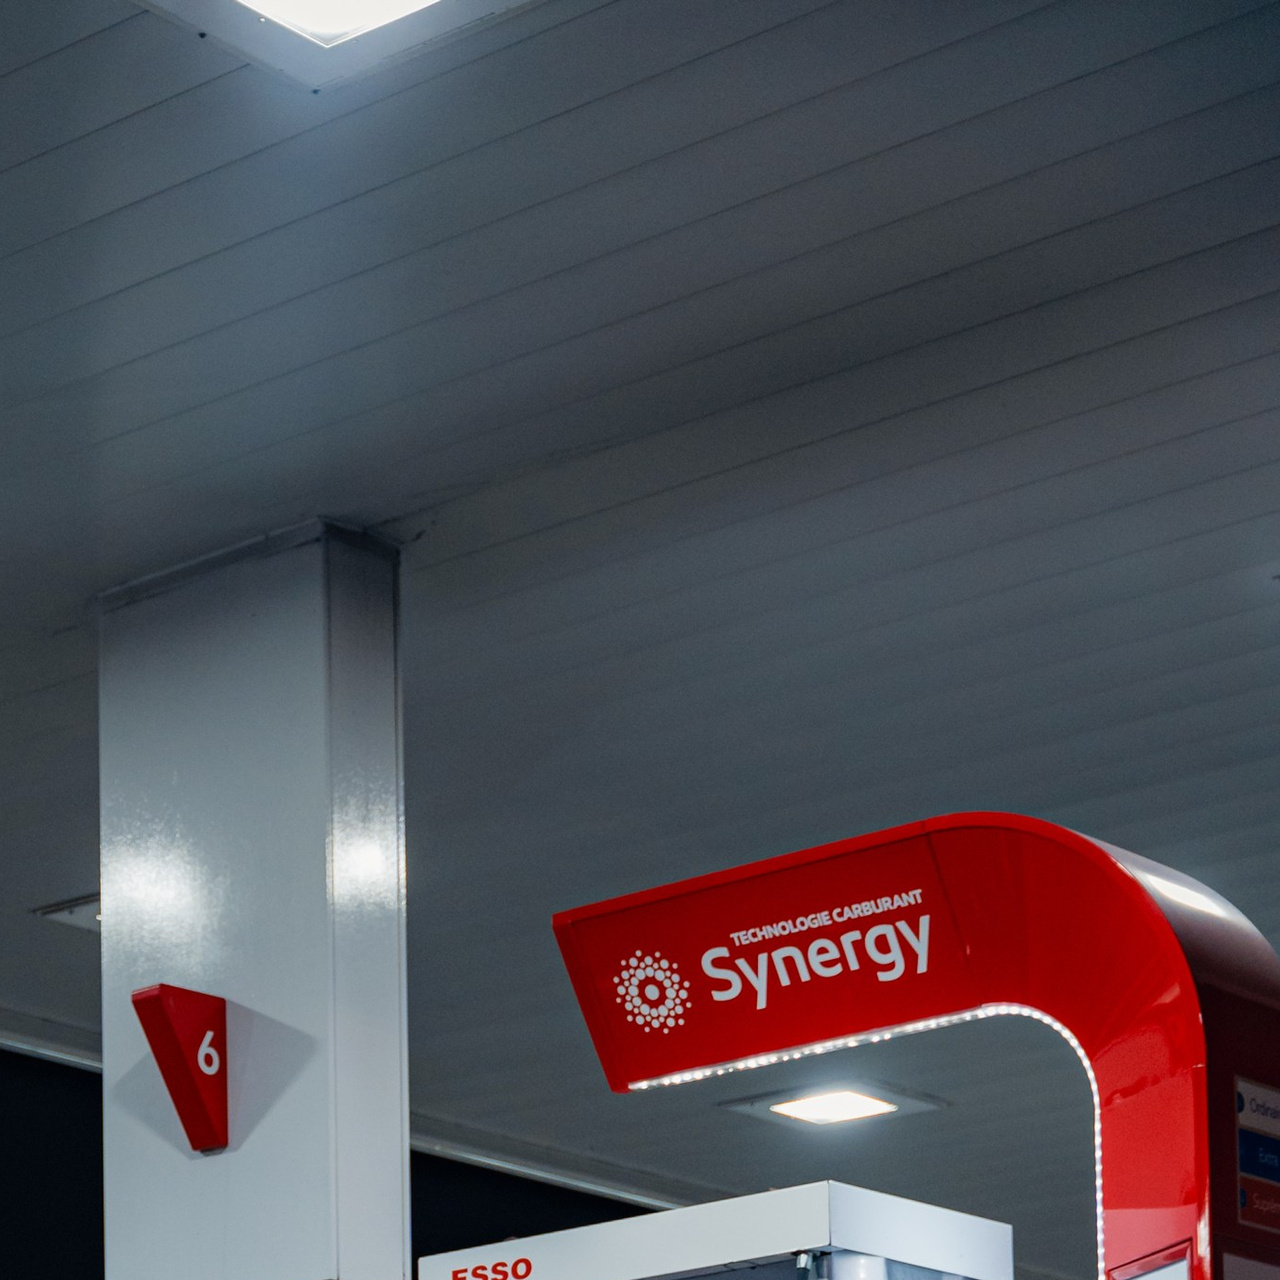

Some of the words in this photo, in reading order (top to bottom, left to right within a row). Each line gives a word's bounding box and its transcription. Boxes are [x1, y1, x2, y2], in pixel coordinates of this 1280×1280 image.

[730, 911, 832, 947] TECHNOLOGIE
[833, 888, 923, 924] CARBURANT
[700, 914, 931, 1010] Synergy
[197, 1030, 220, 1075] 6
